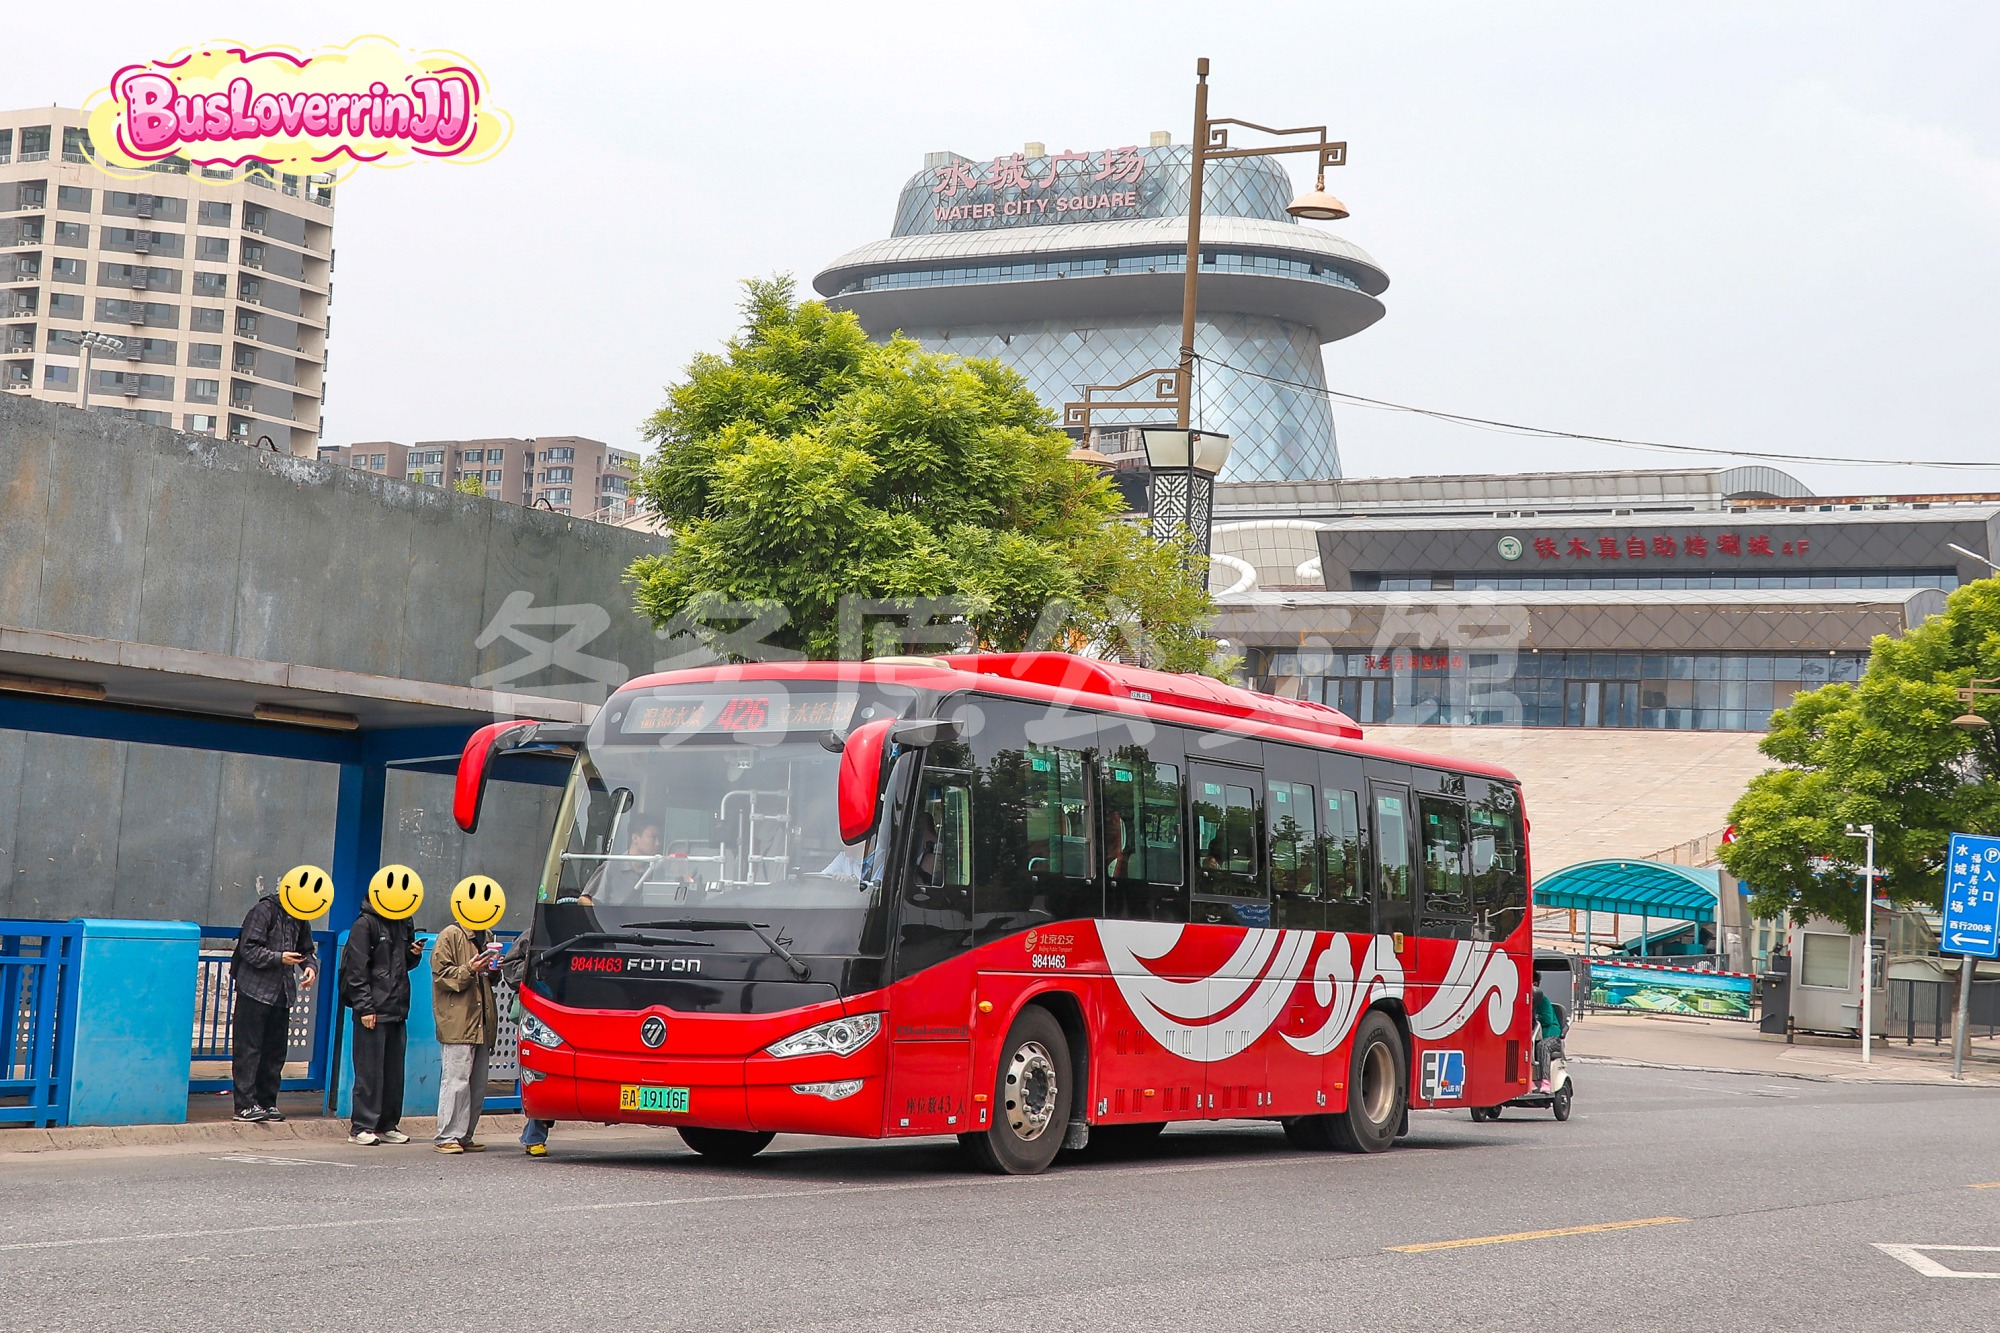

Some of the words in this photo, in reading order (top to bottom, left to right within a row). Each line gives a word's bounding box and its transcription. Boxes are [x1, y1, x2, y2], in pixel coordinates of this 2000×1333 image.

[933, 146, 1145, 196] 水城广场
[934, 203, 995, 221] WATER
[1004, 199, 1049, 216] CITY
[1056, 191, 1137, 212] SQUARE
[1533, 534, 1774, 559] 铁木真自助烤涮城
[1781, 540, 1809, 556] 4F
[717, 697, 769, 731] 426
[1950, 844, 1969, 913] 水城广场
[1982, 870, 1996, 902] 入口
[1040, 934, 1074, 945] 北京公交
[1949, 920, 1992, 933] 西行200米
[571, 956, 623, 973] 9841463
[627, 958, 701, 973] FOTON
[1032, 953, 1066, 969] 9841463
